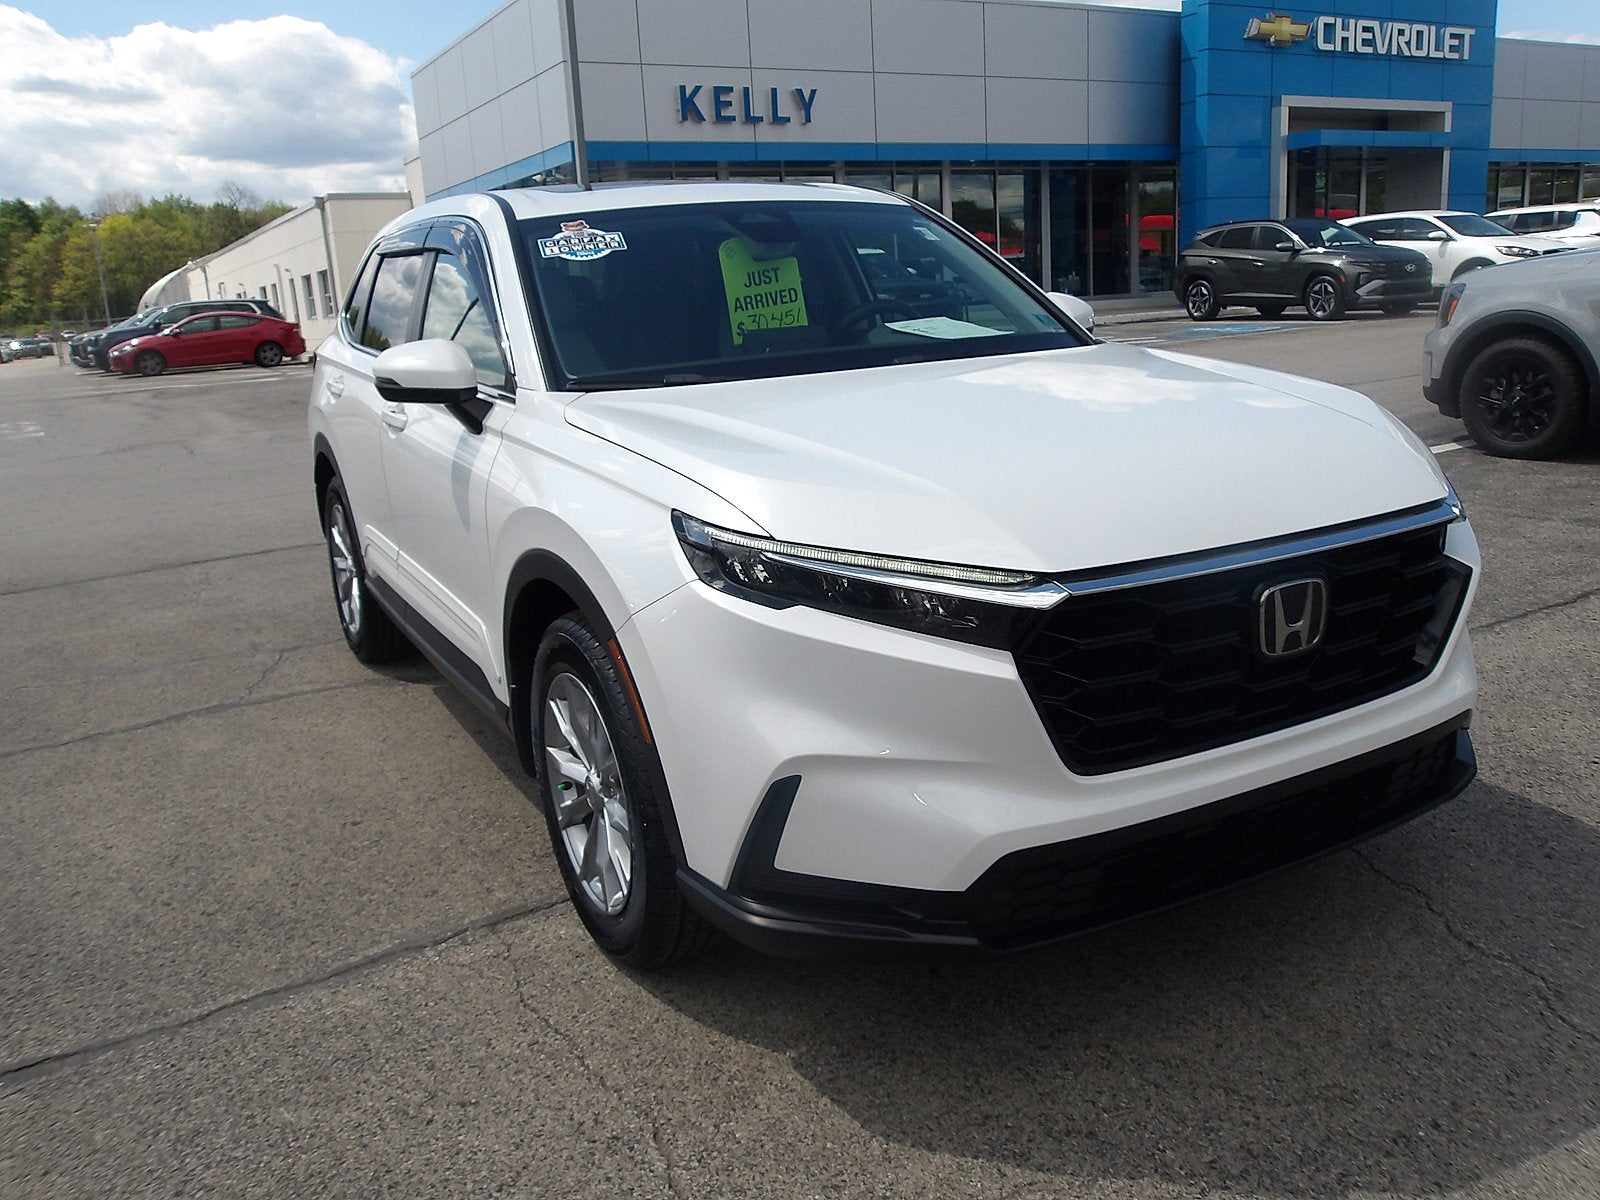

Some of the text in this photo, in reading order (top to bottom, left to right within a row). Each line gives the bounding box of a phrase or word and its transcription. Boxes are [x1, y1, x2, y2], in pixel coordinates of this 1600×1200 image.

[1316, 15, 1476, 60] CHEVROLET
[678, 84, 818, 124] KELLY
[545, 235, 617, 248] CARFAX
[559, 241, 620, 253] OWNER
[743, 267, 780, 288] JUST
[734, 287, 799, 313] ARRIVED
